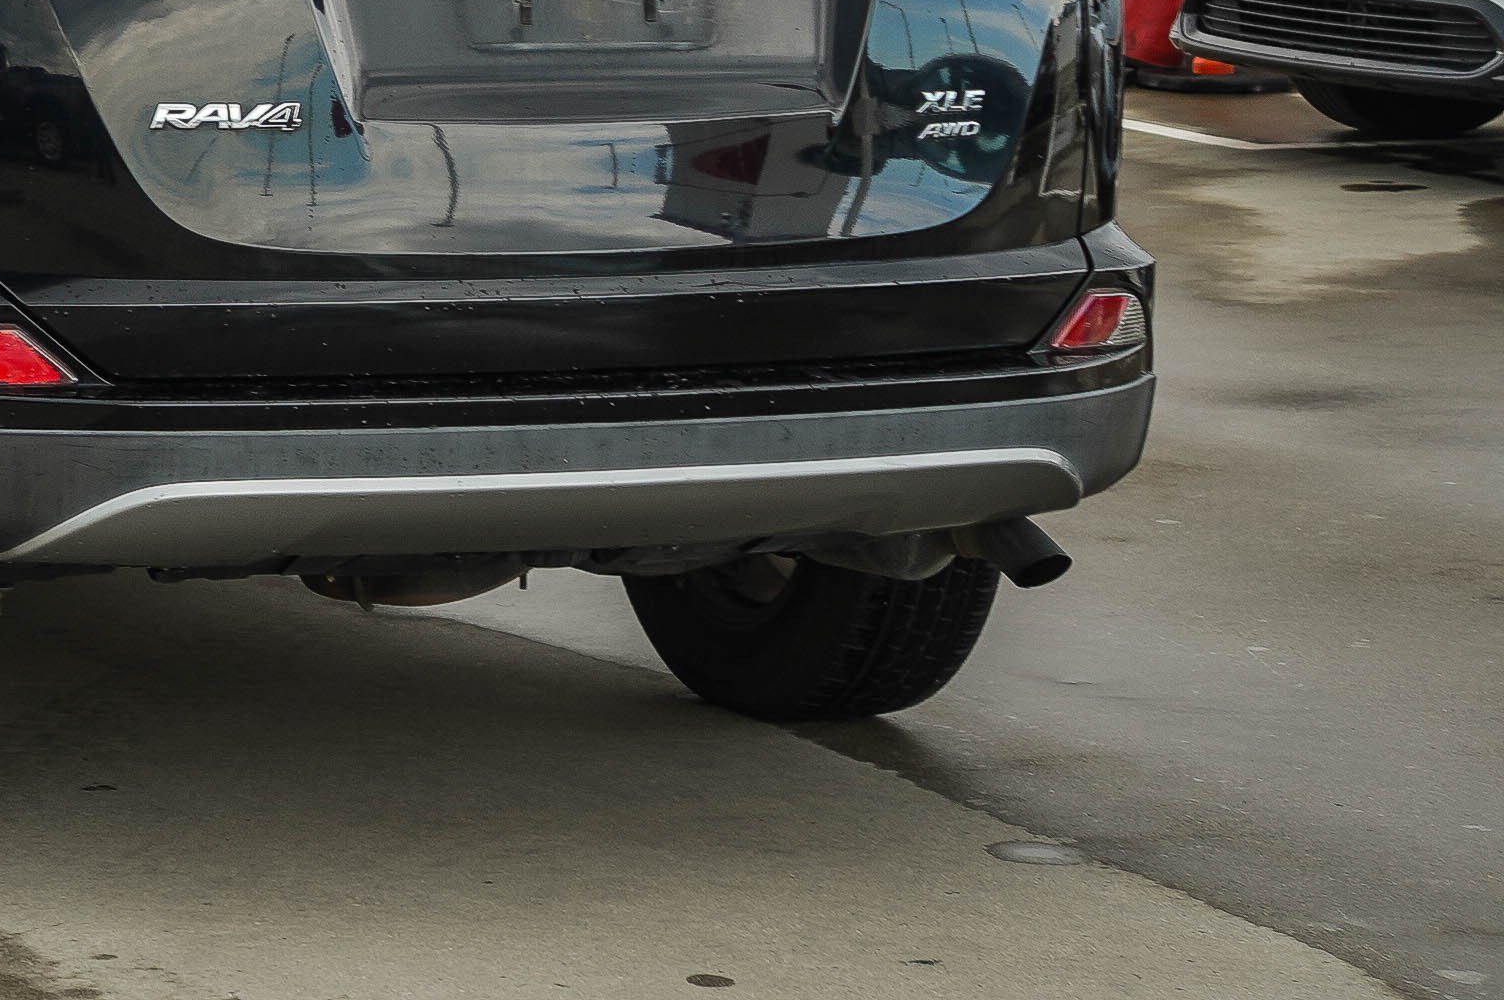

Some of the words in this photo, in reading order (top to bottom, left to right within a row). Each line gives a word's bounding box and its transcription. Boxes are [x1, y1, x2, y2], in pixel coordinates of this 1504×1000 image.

[915, 90, 986, 113] XLE
[149, 102, 304, 131] RAV4
[917, 121, 982, 139] AWD
